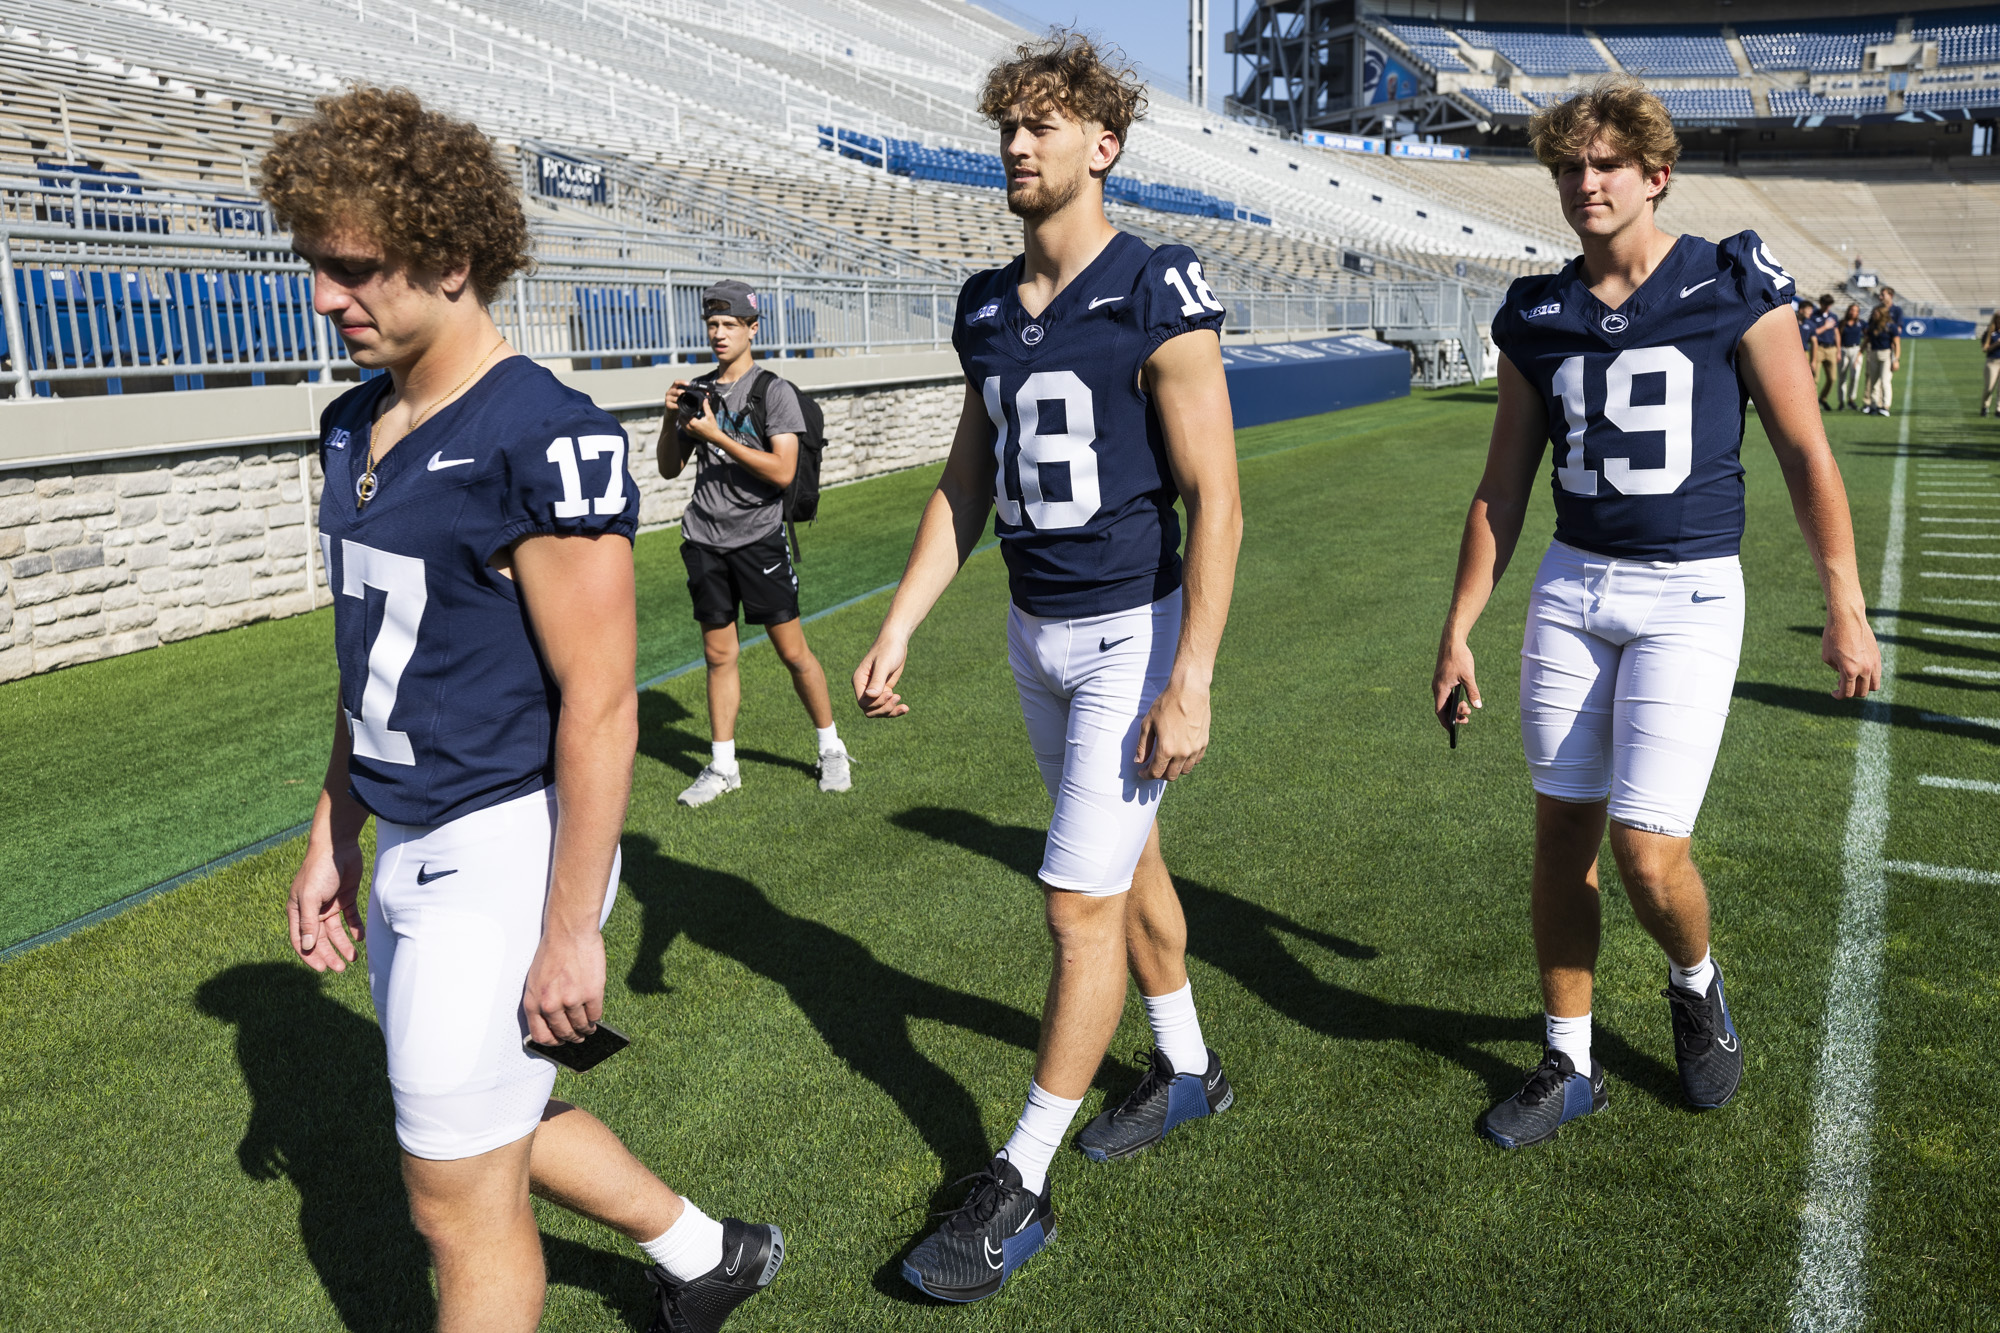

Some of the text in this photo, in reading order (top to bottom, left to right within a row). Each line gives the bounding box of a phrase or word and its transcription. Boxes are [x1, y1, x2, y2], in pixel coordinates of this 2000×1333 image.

[1163, 261, 1224, 318] 18
[546, 434, 628, 518] 17
[982, 370, 1102, 530] 18
[1551, 345, 1694, 496] 19
[319, 532, 428, 766] 7
